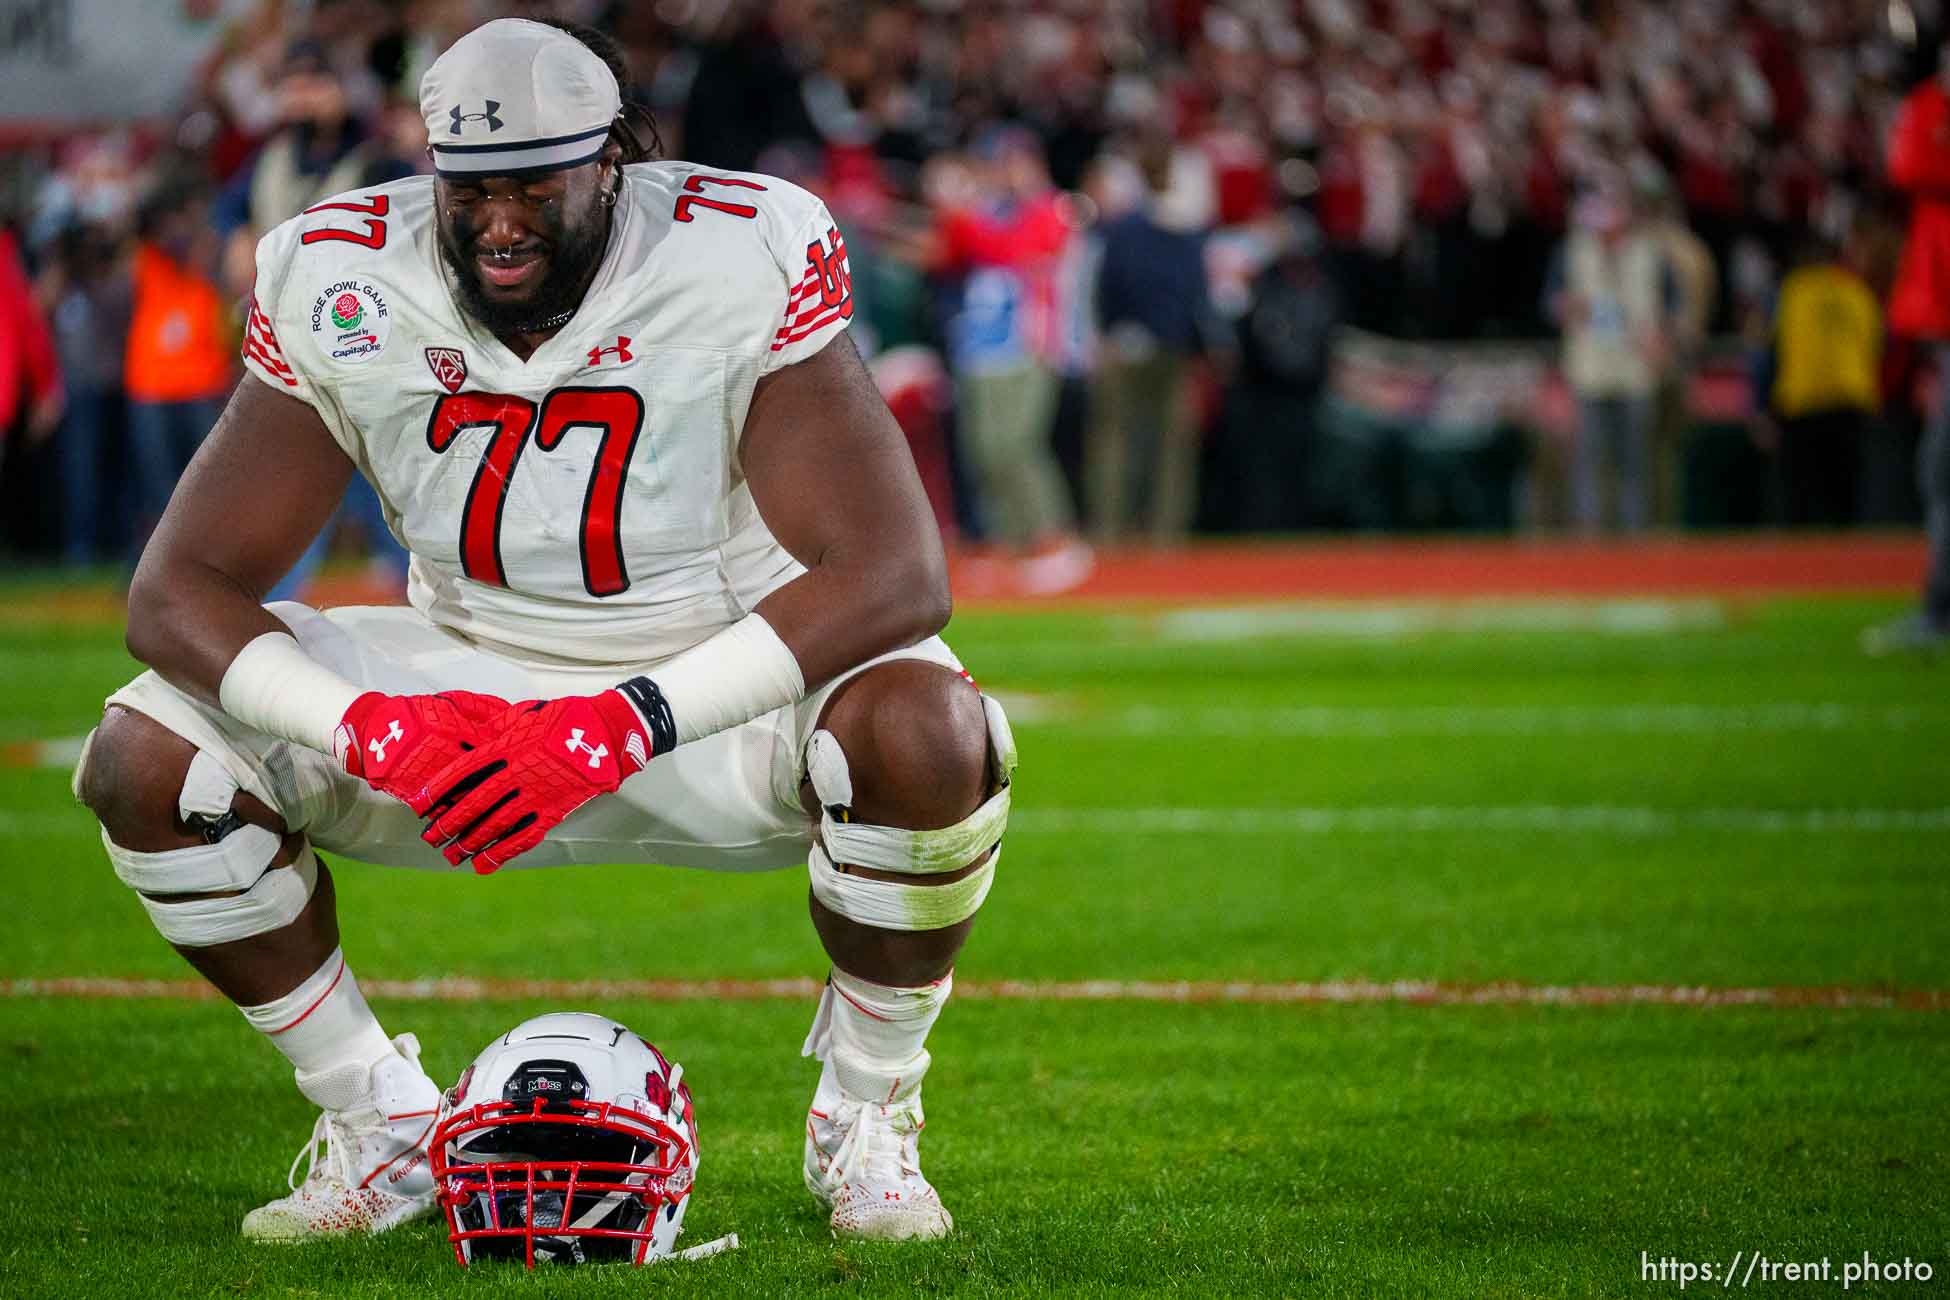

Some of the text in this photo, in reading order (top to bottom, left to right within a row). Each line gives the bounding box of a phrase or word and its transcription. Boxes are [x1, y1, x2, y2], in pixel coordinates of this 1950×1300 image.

[301, 194, 389, 250] 77
[672, 174, 769, 223] 77
[311, 281, 388, 332] ROSE BOWL GAME
[337, 328, 369, 342] presented by
[427, 350, 465, 376] PAC
[440, 366, 461, 383] 12
[426, 386, 645, 598] 77
